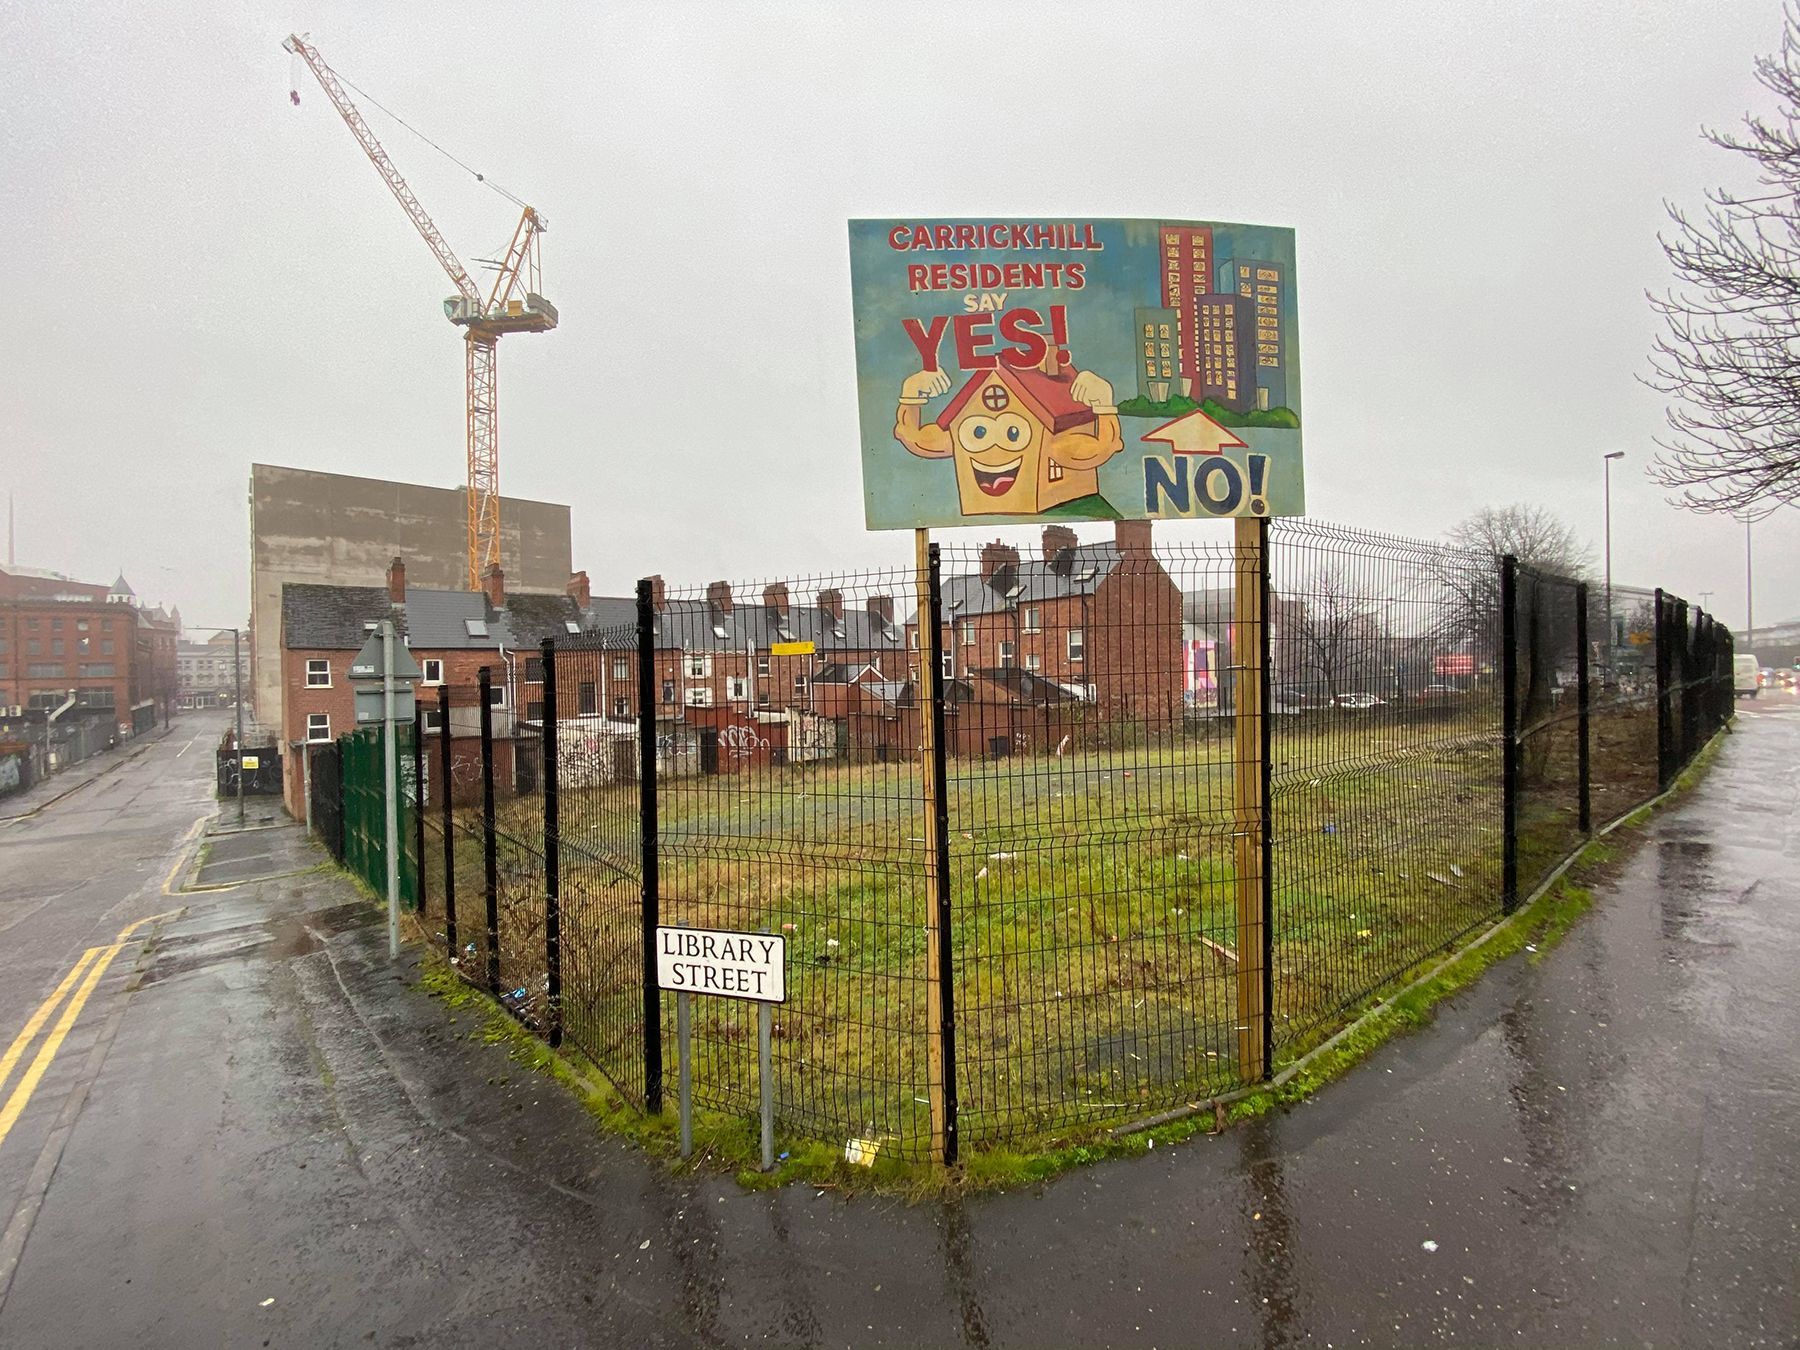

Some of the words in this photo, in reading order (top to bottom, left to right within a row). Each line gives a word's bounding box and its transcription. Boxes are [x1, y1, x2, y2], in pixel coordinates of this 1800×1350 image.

[888, 223, 1104, 252] CARRICKHILL
[908, 263, 1086, 291] RESIDENTS
[963, 293, 1008, 313] SAY
[902, 305, 1071, 371] YES!
[1142, 453, 1272, 518] NO!
[663, 933, 775, 964] LIBRARY
[672, 962, 767, 994] STREET
